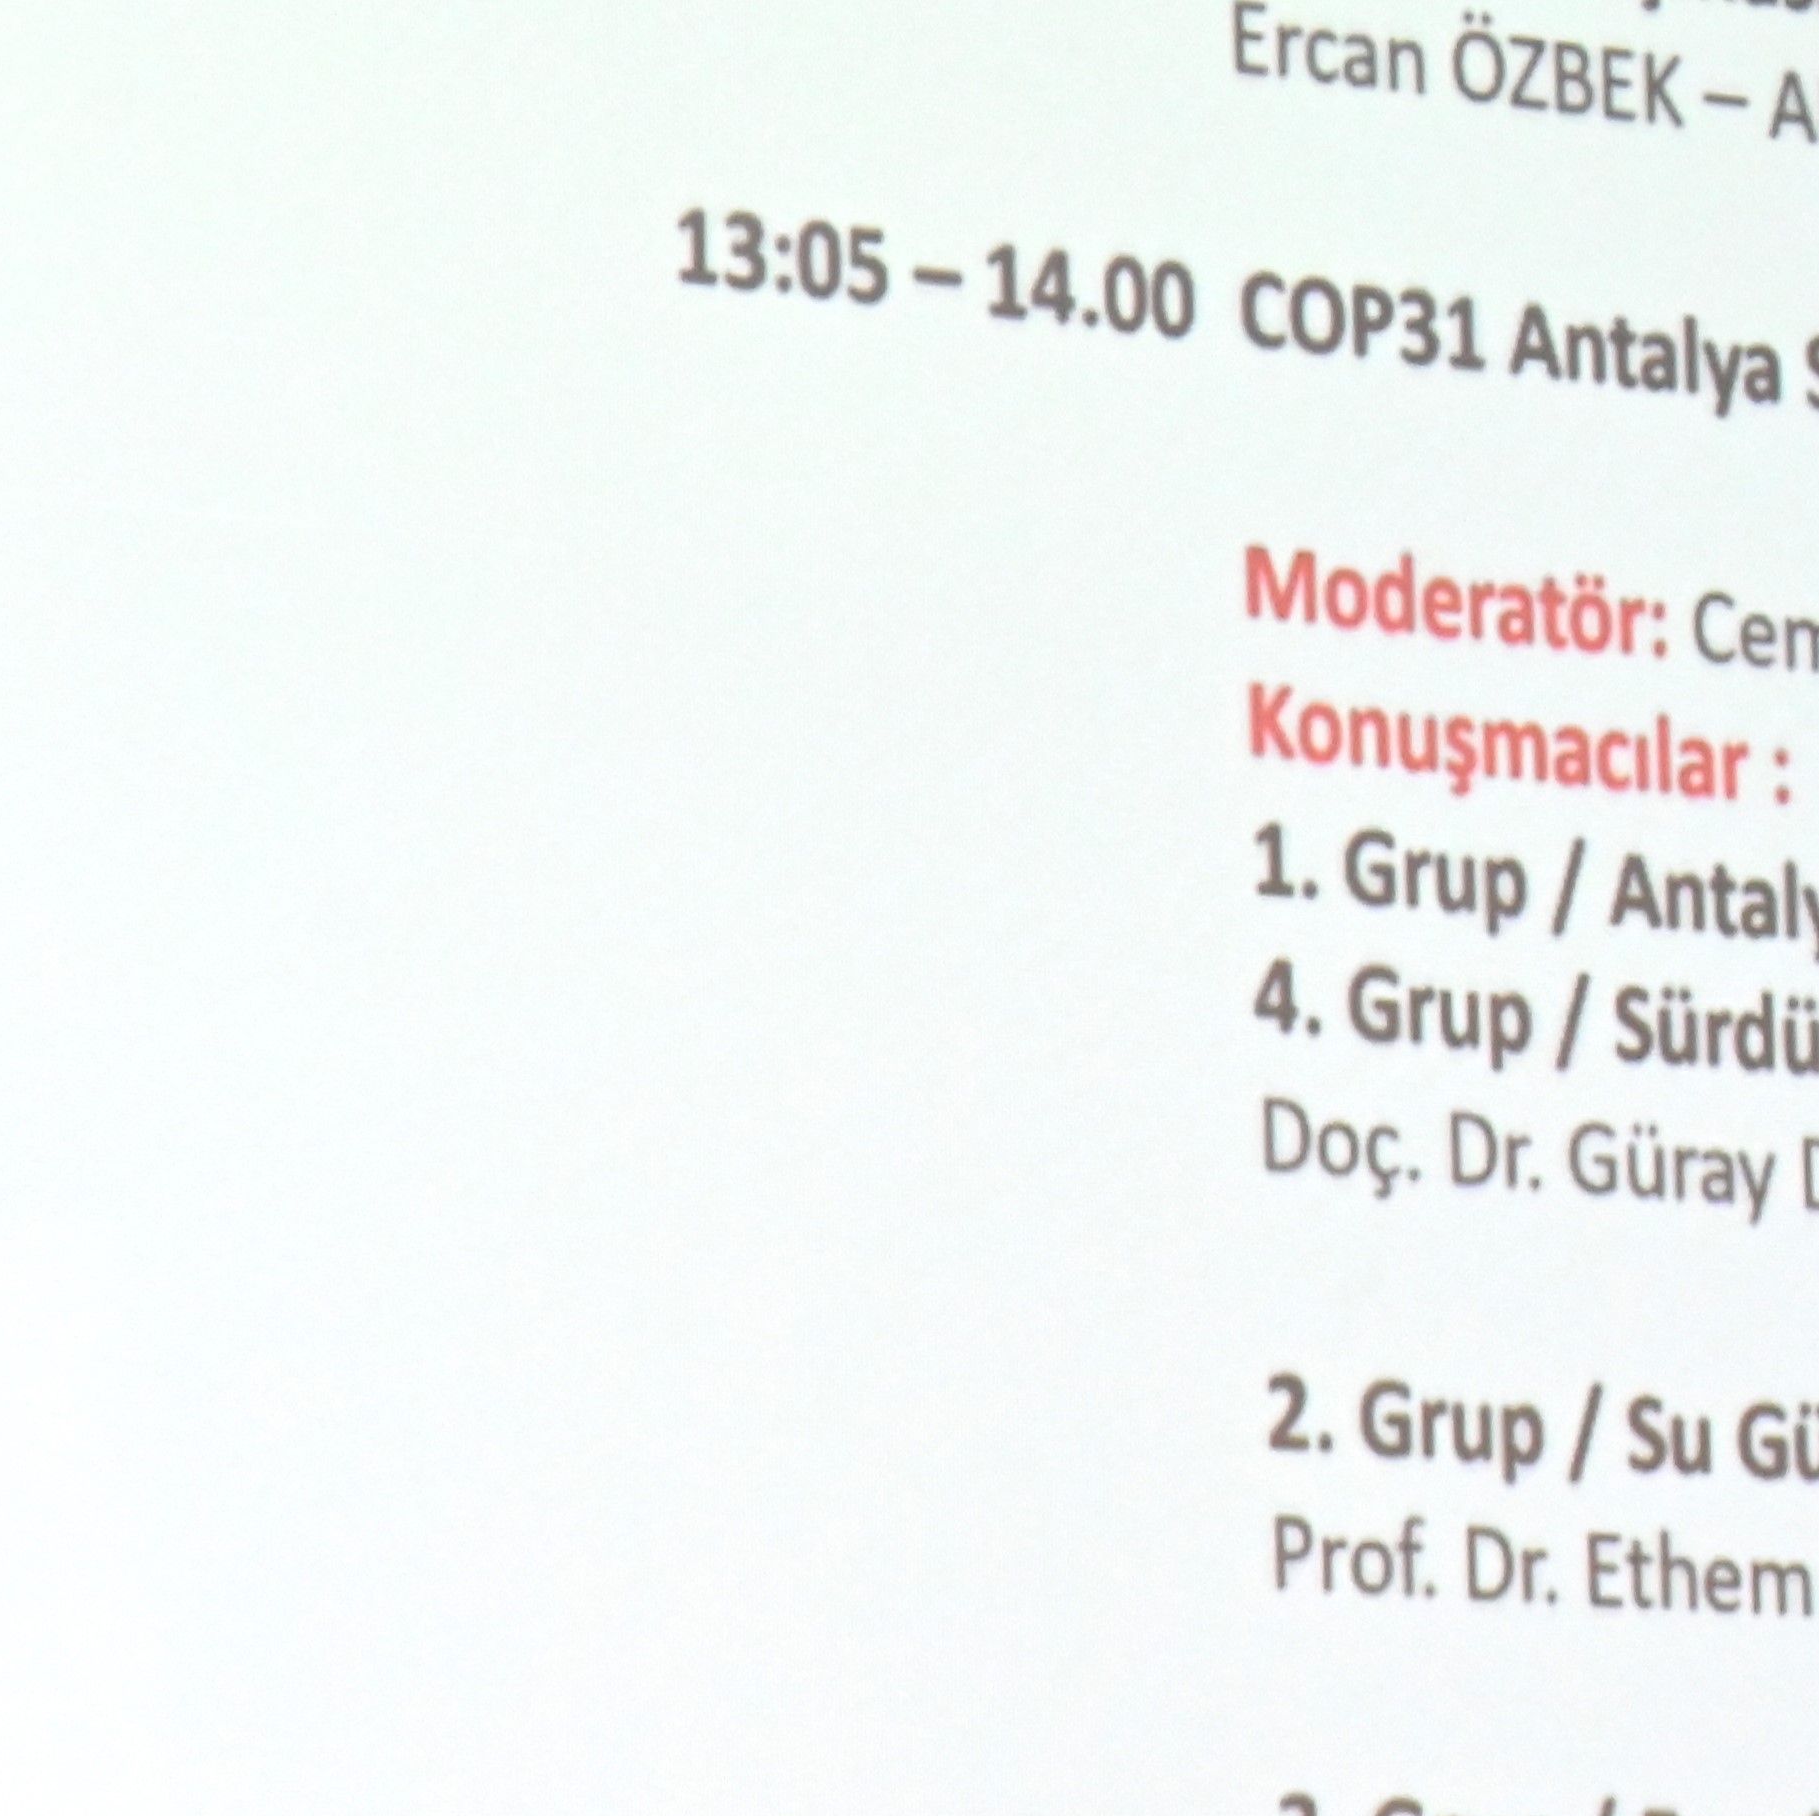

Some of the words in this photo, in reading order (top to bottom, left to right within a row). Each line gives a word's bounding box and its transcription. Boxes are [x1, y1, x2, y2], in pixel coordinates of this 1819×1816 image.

[1232, 0, 1427, 95] Ercan
[1451, 11, 1685, 129] ÖZBEK
[677, 207, 890, 306] 13:05
[986, 243, 1197, 341] 14.00
[1240, 269, 1487, 373] COP31
[1508, 302, 1783, 420] Antalya
[1245, 543, 1668, 659] Moderatör:
[1248, 681, 1750, 801] Konuşmacılar
[1255, 821, 1319, 901] 1.
[1343, 827, 1529, 938] Grup
[1253, 957, 1322, 1037] 4.
[1347, 963, 1533, 1073] Grup
[1614, 984, 1819, 1077] Sürdü
[1263, 1096, 1421, 1200] Doç.
[1449, 1110, 1541, 1191] Dr.
[1567, 1118, 1776, 1225] Güray
[1268, 1371, 1334, 1453] 2.
[1359, 1378, 1545, 1486] Grup
[1626, 1393, 1713, 1477] Su
[1274, 1513, 1436, 1598] Prof.
[1466, 1524, 1558, 1605] Dr.
[1586, 1529, 1814, 1617] Ethem
